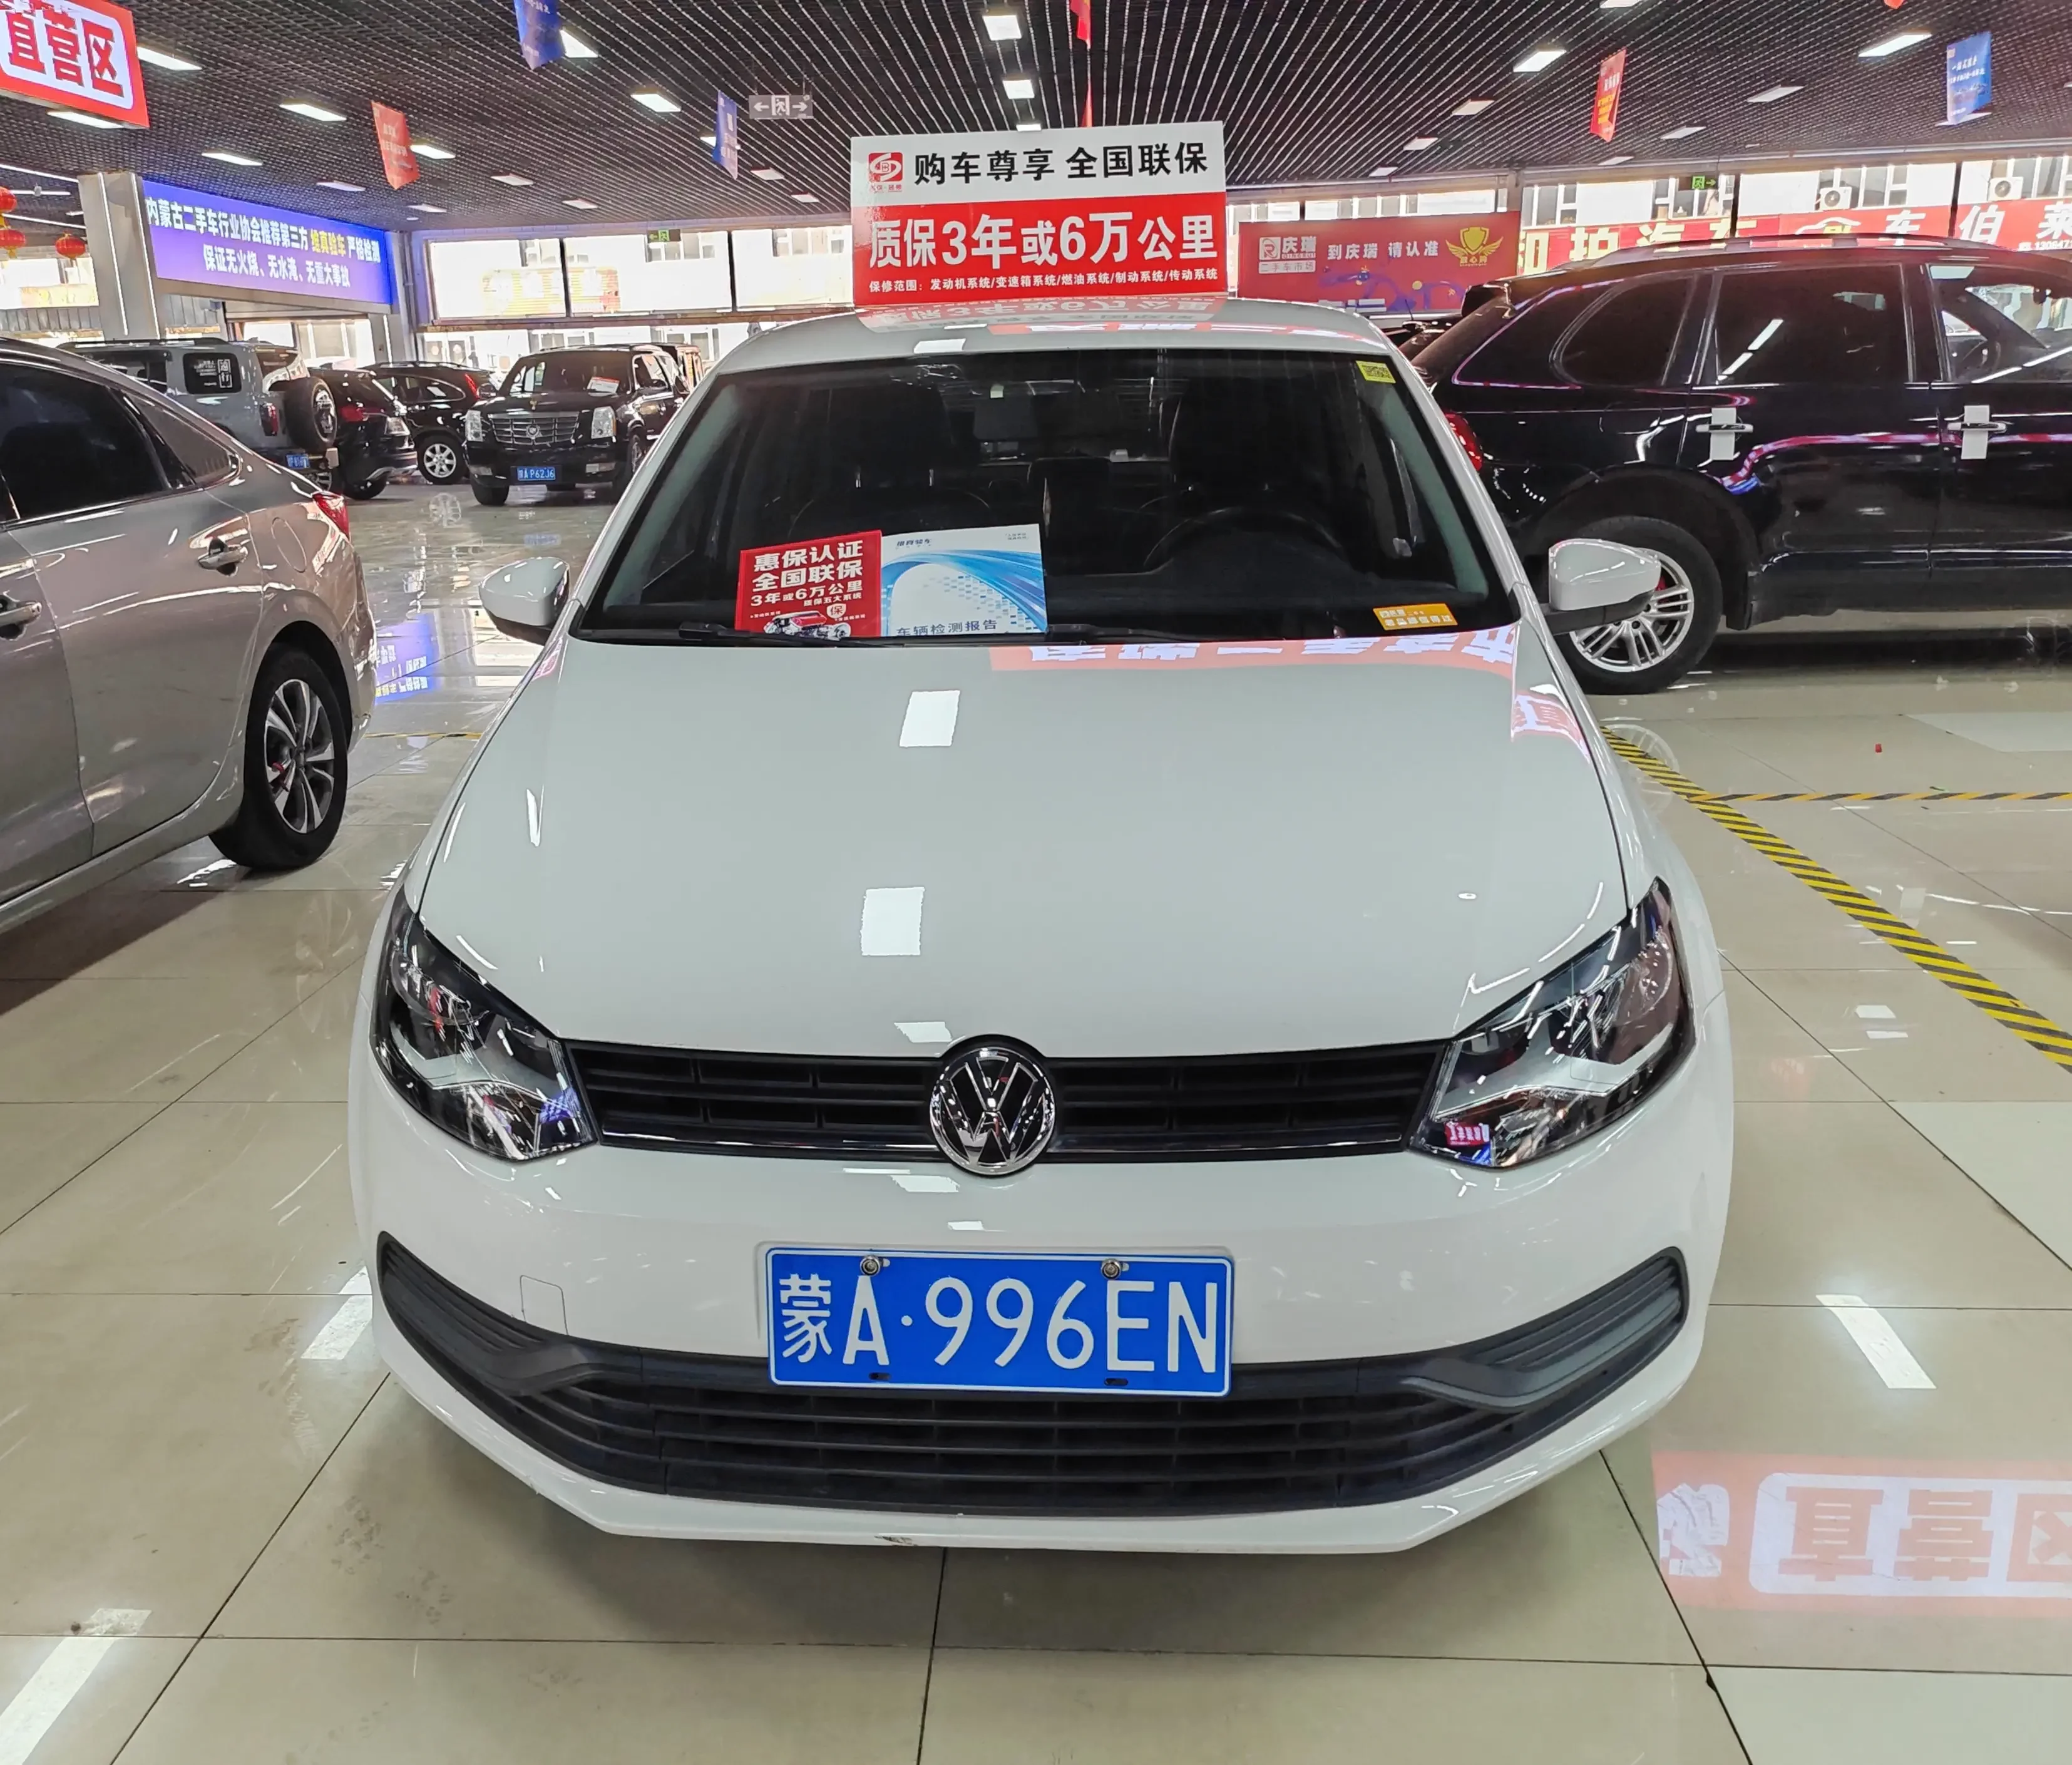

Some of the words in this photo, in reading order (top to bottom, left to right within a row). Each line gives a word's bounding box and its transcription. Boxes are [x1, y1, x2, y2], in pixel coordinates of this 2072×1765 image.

[914, 148, 1055, 185] 购车尊享
[1065, 141, 1209, 180] 全国联保
[869, 210, 1218, 270] 质保3年或6万公里
[1282, 235, 1316, 253] 庆瑞
[1327, 243, 1378, 260] 到庆瑞
[1388, 240, 1439, 258] 请认准
[754, 540, 863, 572] 惠保认证
[752, 560, 863, 592] 全国联保
[751, 580, 863, 607] 3年或6万公里
[896, 620, 997, 637] 车辆检测报告
